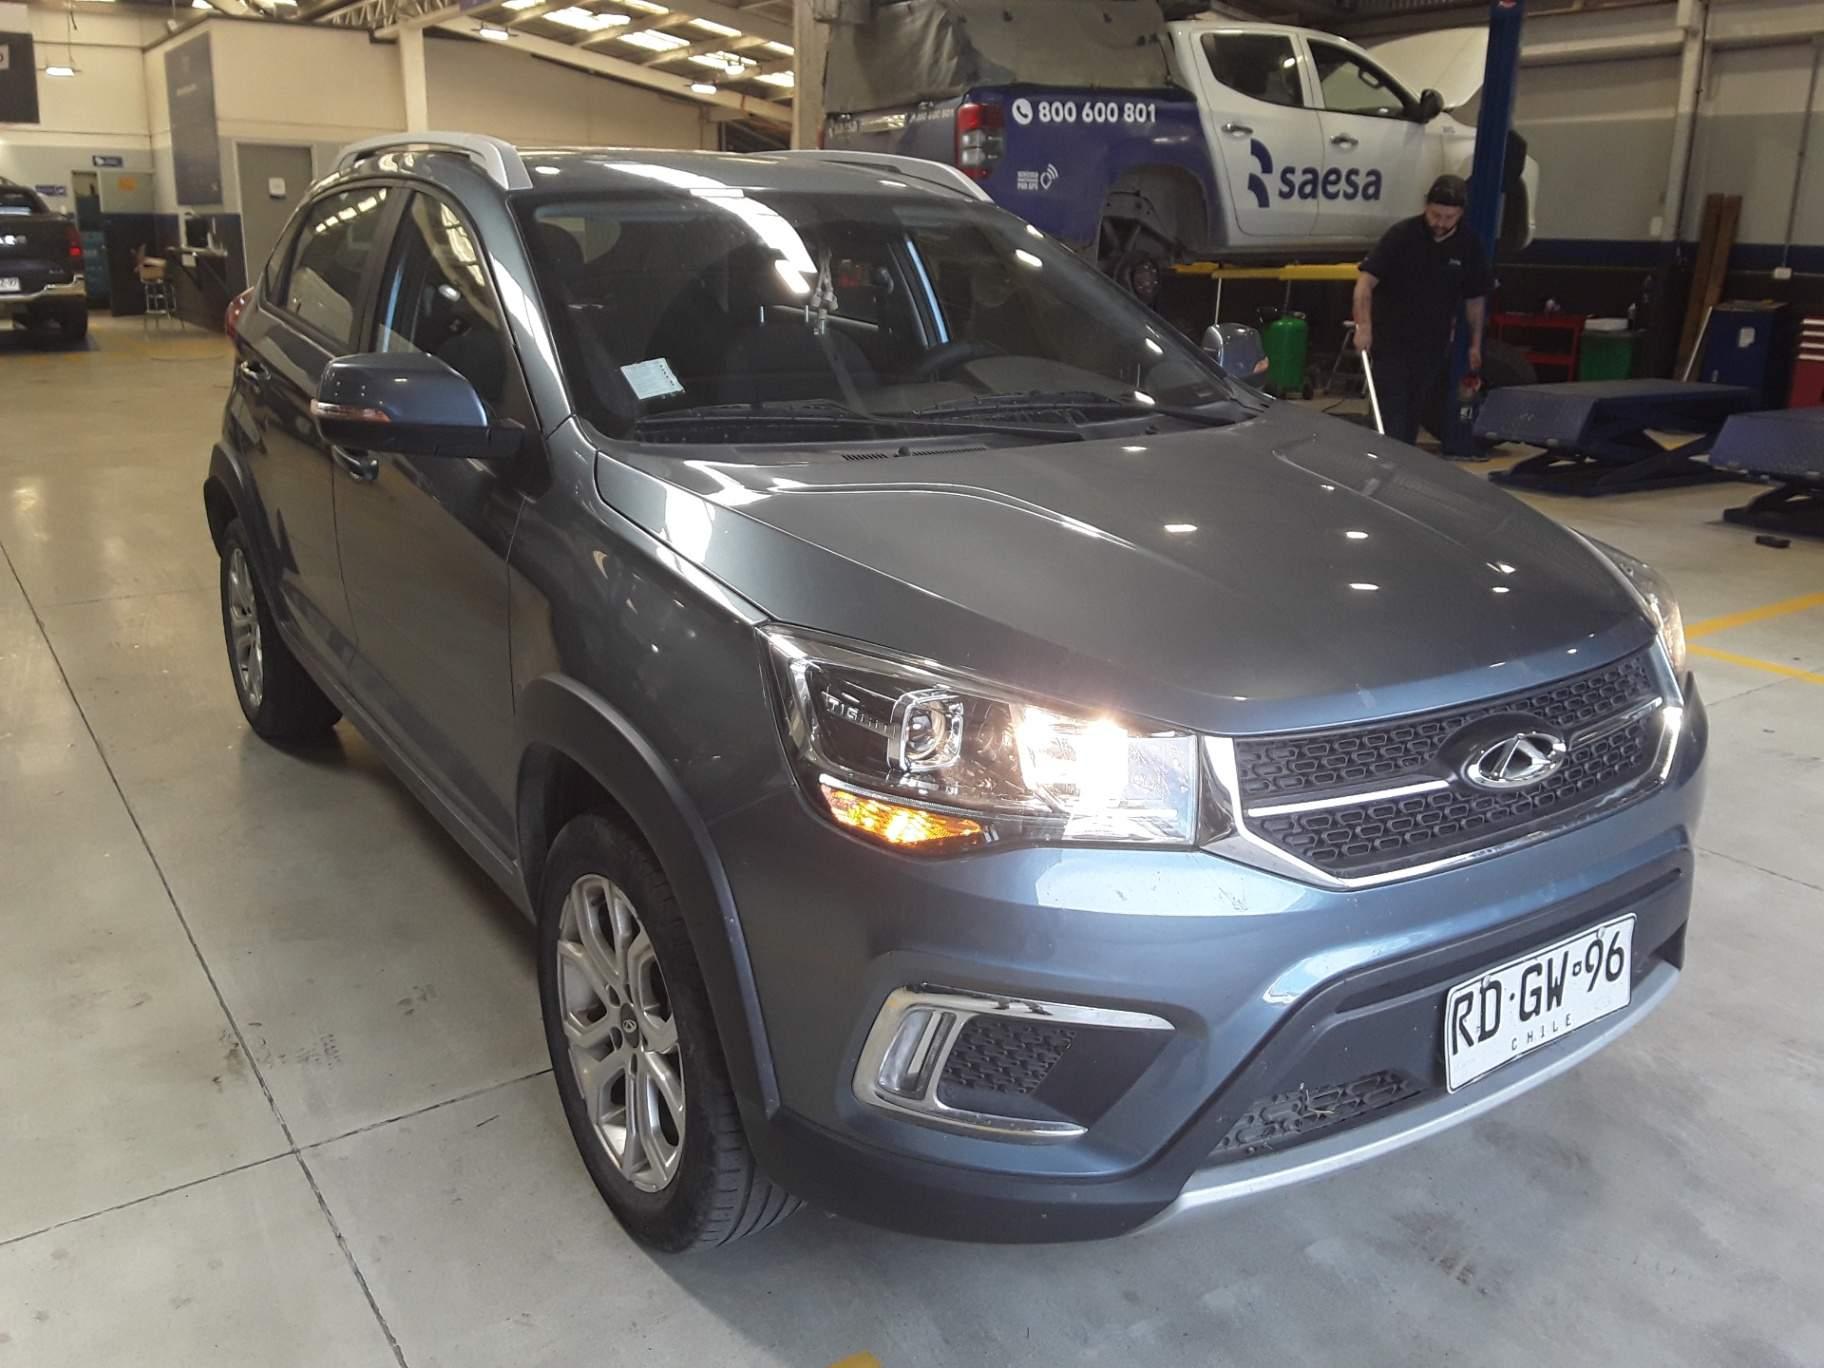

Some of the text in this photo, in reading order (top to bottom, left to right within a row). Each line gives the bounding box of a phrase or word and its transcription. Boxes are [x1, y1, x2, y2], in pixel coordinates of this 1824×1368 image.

[1039, 101, 1156, 122] 800 600 801
[1278, 165, 1382, 202] saesa
[1511, 1013, 1572, 1051] CHILE
